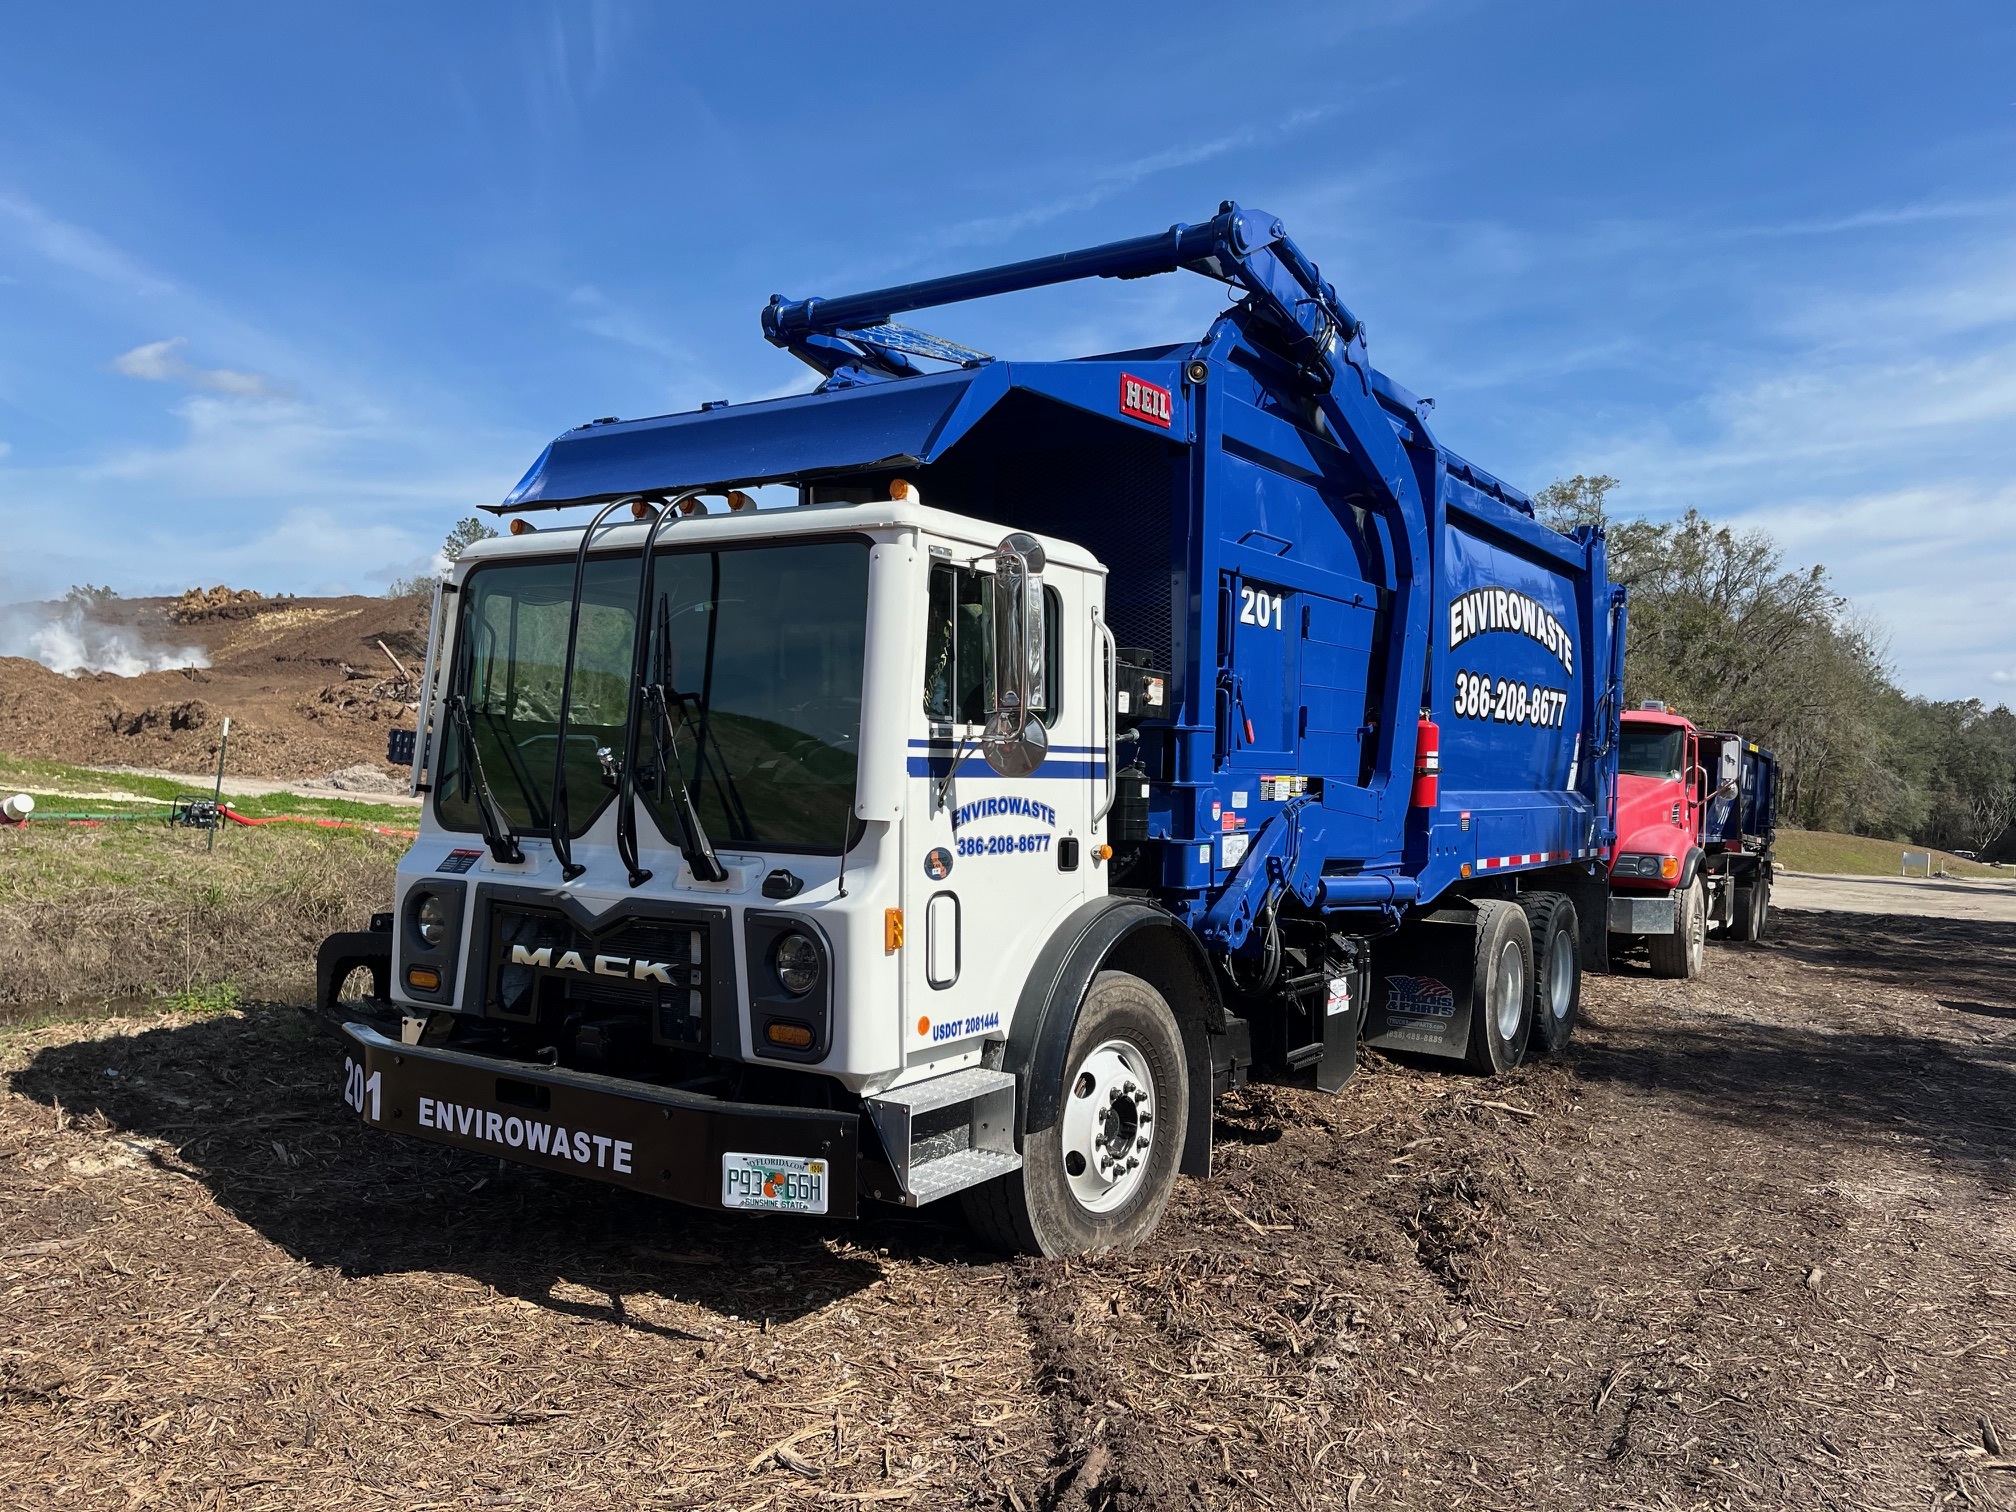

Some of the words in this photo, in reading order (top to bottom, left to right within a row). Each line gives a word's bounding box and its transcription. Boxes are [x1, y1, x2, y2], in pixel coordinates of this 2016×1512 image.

[1126, 380, 1170, 420] HEIL
[1240, 586, 1283, 631] 201
[1449, 588, 1574, 676] ENVIROWASTE
[1455, 671, 1568, 728] 386-208-8677
[952, 796, 1055, 831] ENVIROWASTE
[957, 834, 1051, 857] 386-208-8677
[512, 945, 679, 986] MACK
[933, 1021, 963, 1041] USDOT
[965, 1012, 999, 1034] 2081444
[1399, 1002, 1454, 1017] PARTS
[344, 1056, 383, 1121] 201
[419, 1096, 633, 1174] ENVIROWASTE
[746, 1158, 806, 1171] MYFLORIDA.COM
[728, 1169, 763, 1196] P93
[787, 1173, 821, 1201] 66H
[746, 1198, 779, 1208] SUNSHINE
[781, 1200, 804, 1209] STATE
